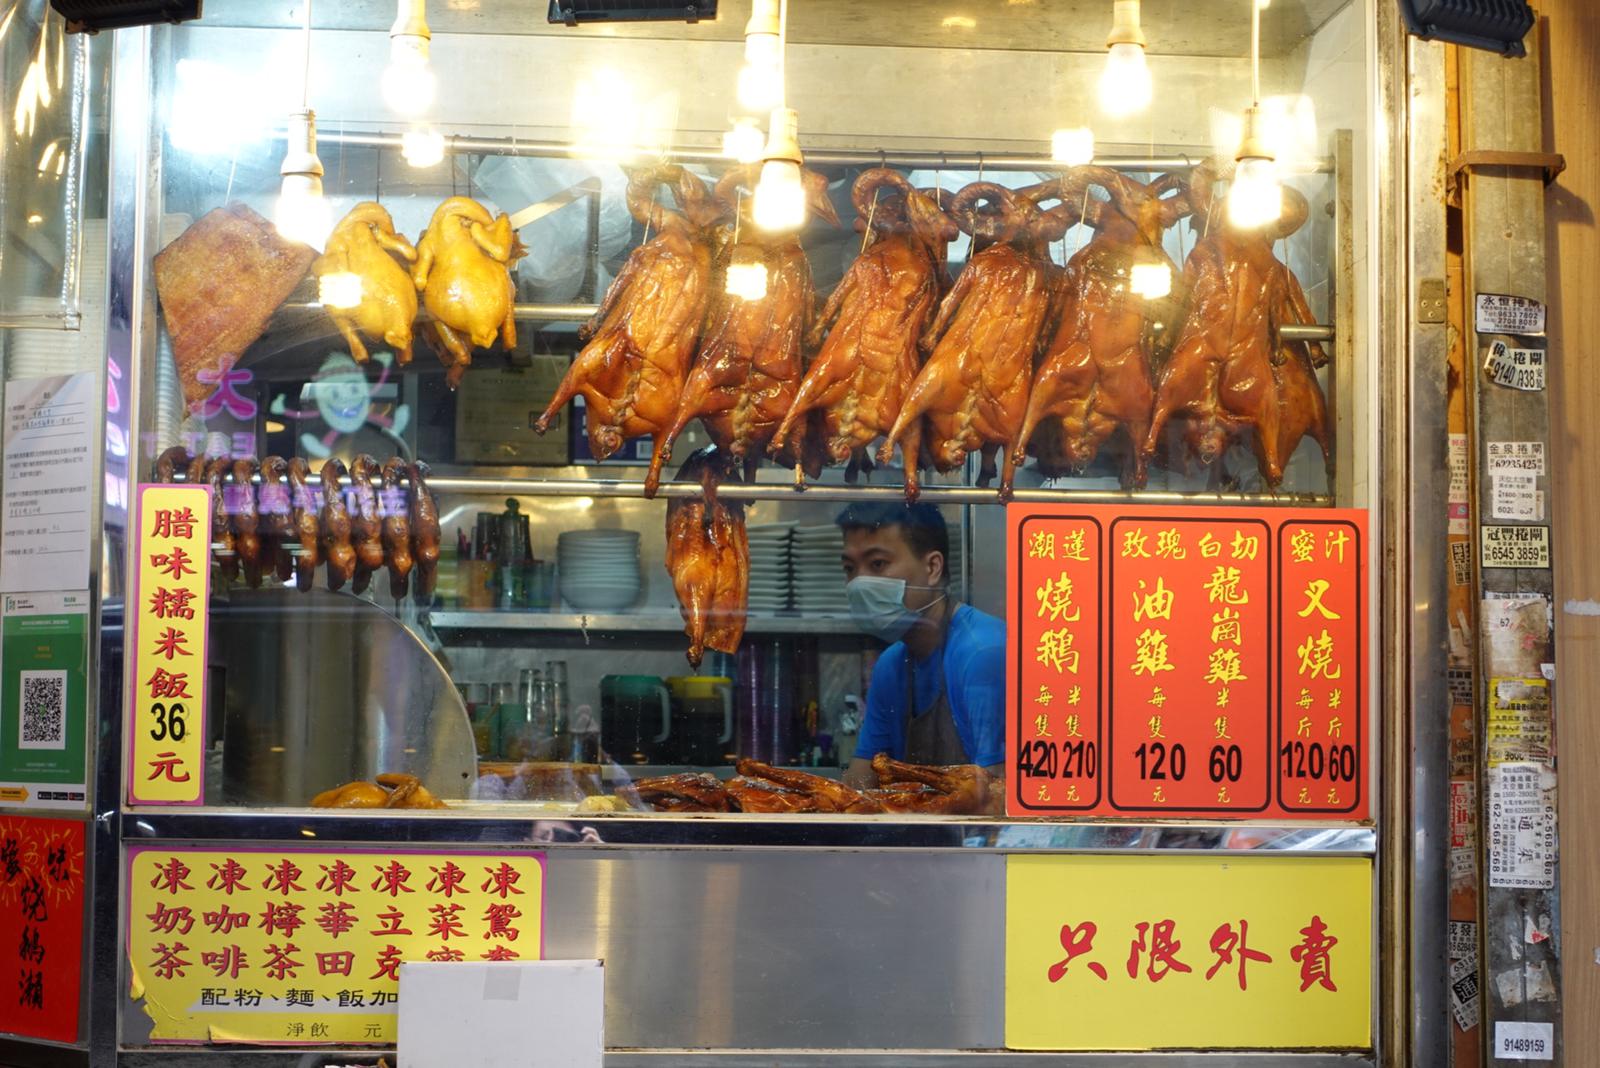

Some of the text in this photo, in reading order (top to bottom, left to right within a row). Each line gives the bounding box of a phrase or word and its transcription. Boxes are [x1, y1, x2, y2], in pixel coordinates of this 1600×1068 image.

[1028, 528, 1091, 562] 潮蓮
[1121, 527, 1187, 560] 玫瑰
[1198, 530, 1259, 561] 白切
[1290, 528, 1351, 563] 蜜汁
[1491, 546, 1540, 561] 6545 3859
[1035, 571, 1082, 675] 燒鵝
[1130, 575, 1176, 677] 油雞
[1296, 579, 1342, 680] 叉燒
[150, 702, 186, 741] 36
[148, 751, 191, 782] 元
[1017, 740, 1058, 779] 420
[1038, 785, 1051, 801] 元
[1062, 740, 1096, 779] 210
[1135, 742, 1187, 782] 120
[1208, 744, 1242, 783] 60
[1281, 741, 1324, 780] 120
[1329, 744, 1355, 782] 60
[1067, 785, 1080, 801] 元
[1152, 786, 1166, 803] 元
[1217, 786, 1231, 803] 元
[1298, 787, 1312, 804] 元
[1327, 788, 1340, 804] 元
[146, 857, 197, 981] 凍奶茶
[200, 857, 252, 980] 凍咖啡
[257, 858, 308, 981] 凍檸茶
[314, 859, 361, 978] 凍華田
[1047, 915, 1338, 993] 只限外賣
[286, 1021, 383, 1039] 淨飲 元
[1504, 1038, 1545, 1053] 91489159
